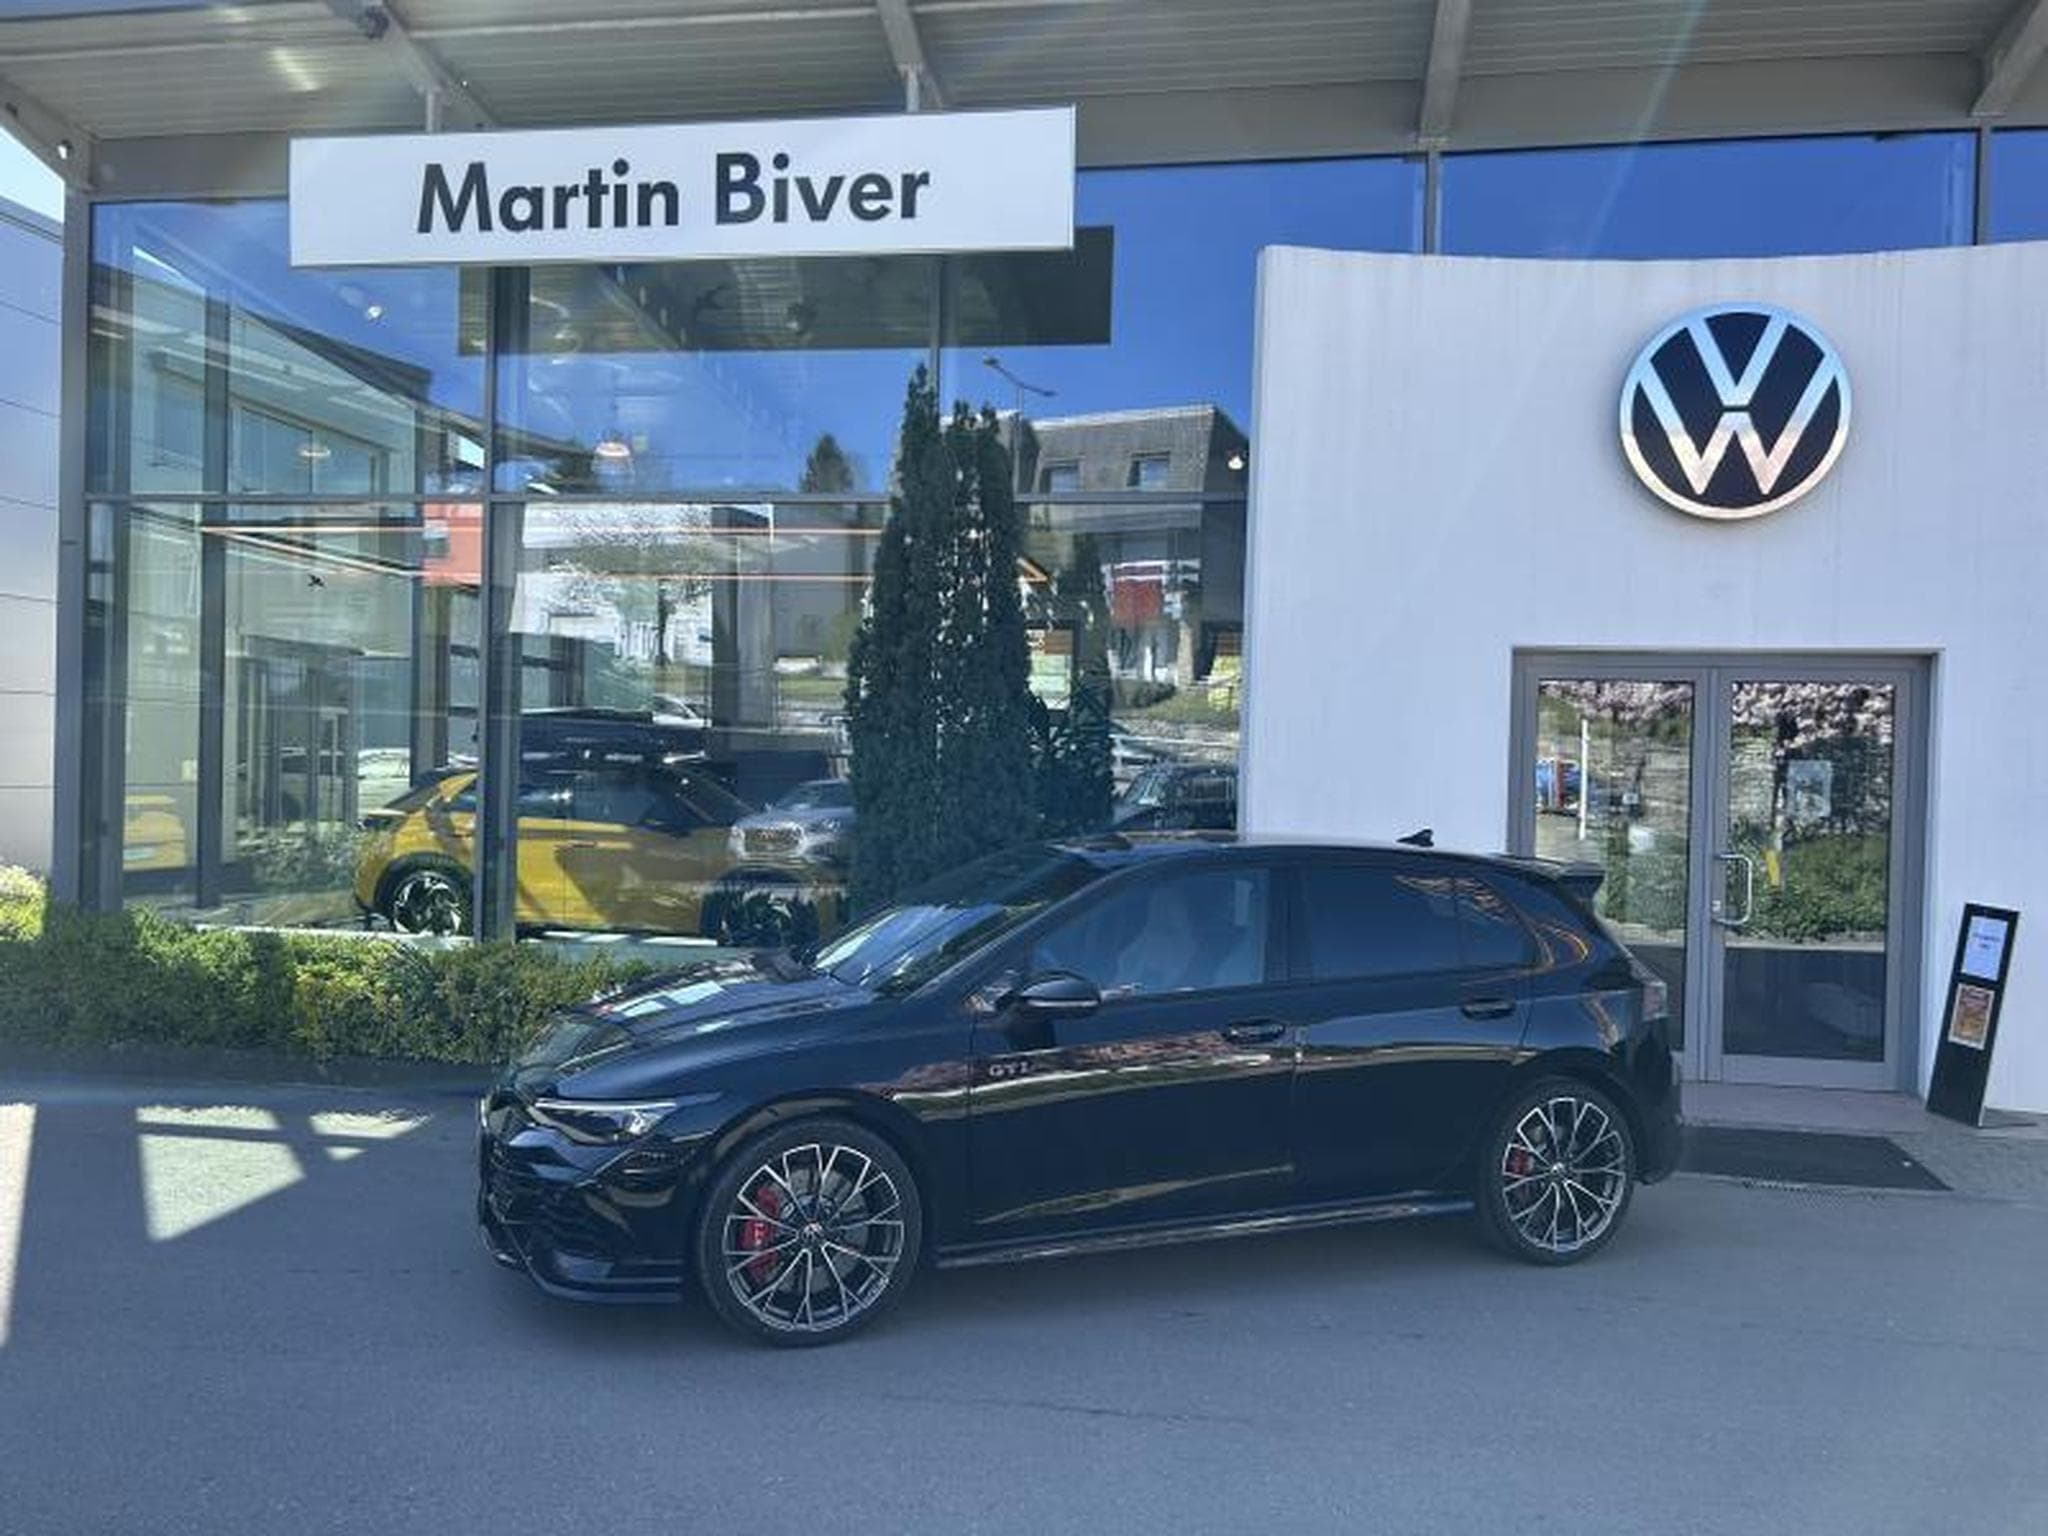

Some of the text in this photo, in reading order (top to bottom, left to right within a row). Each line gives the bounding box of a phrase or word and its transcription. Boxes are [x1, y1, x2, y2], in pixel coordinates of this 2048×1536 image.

[417, 152, 930, 234] Martin Biver
[1634, 307, 1841, 496] VW
[989, 1061, 1029, 1077] GTI
